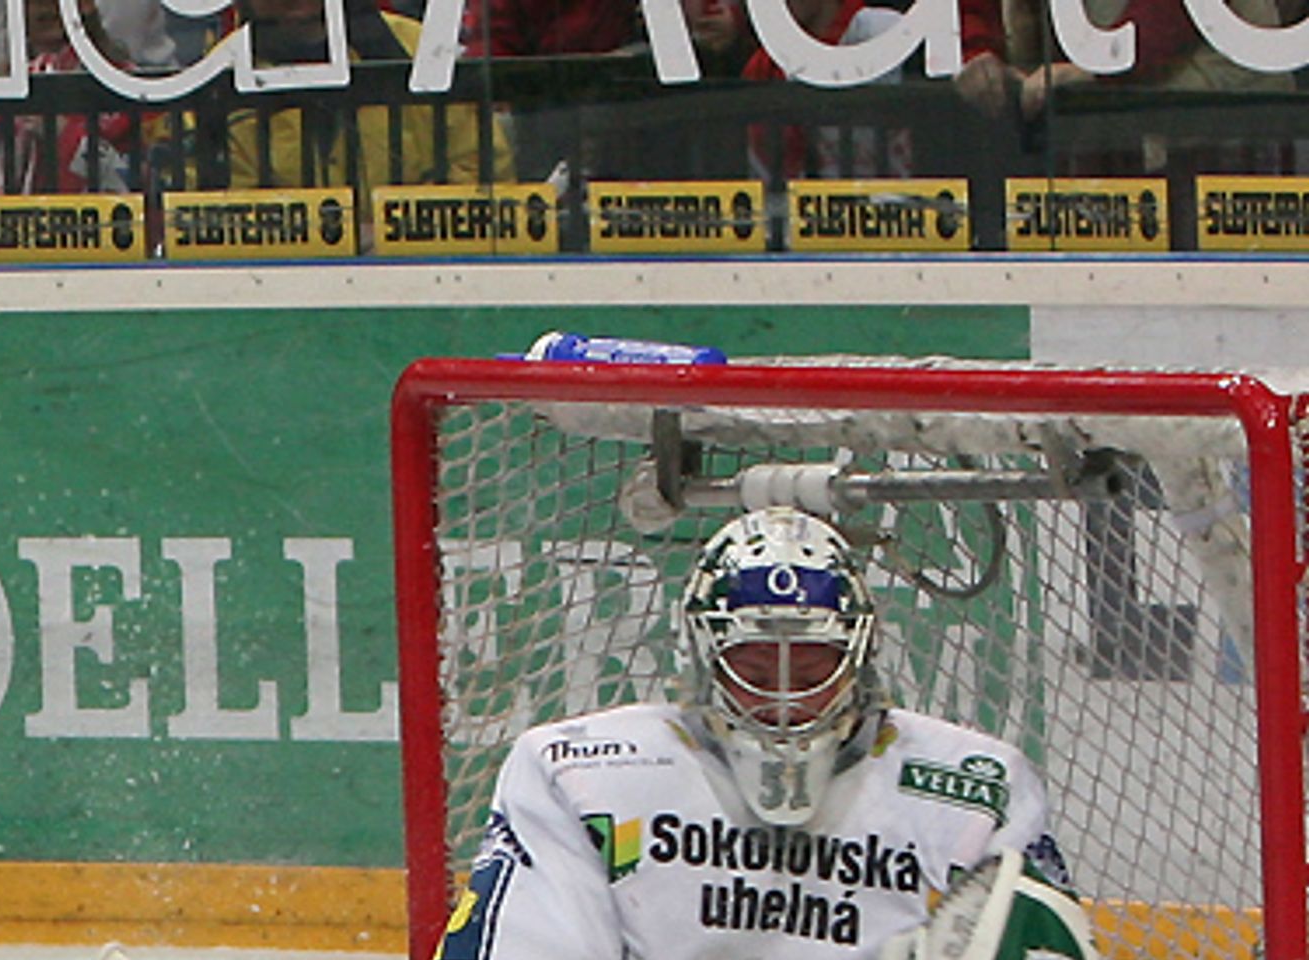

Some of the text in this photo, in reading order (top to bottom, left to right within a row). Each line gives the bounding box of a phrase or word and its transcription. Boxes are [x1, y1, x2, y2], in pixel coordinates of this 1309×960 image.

[175, 202, 309, 246] SUBTERRA
[385, 198, 518, 242] SUBTERRA
[599, 194, 723, 239] SUBTERRA
[798, 194, 926, 239] SUBTERRA
[909, 766, 994, 802] VELTA
[649, 812, 922, 894] Sokolovská
[700, 874, 860, 946] uhelná
